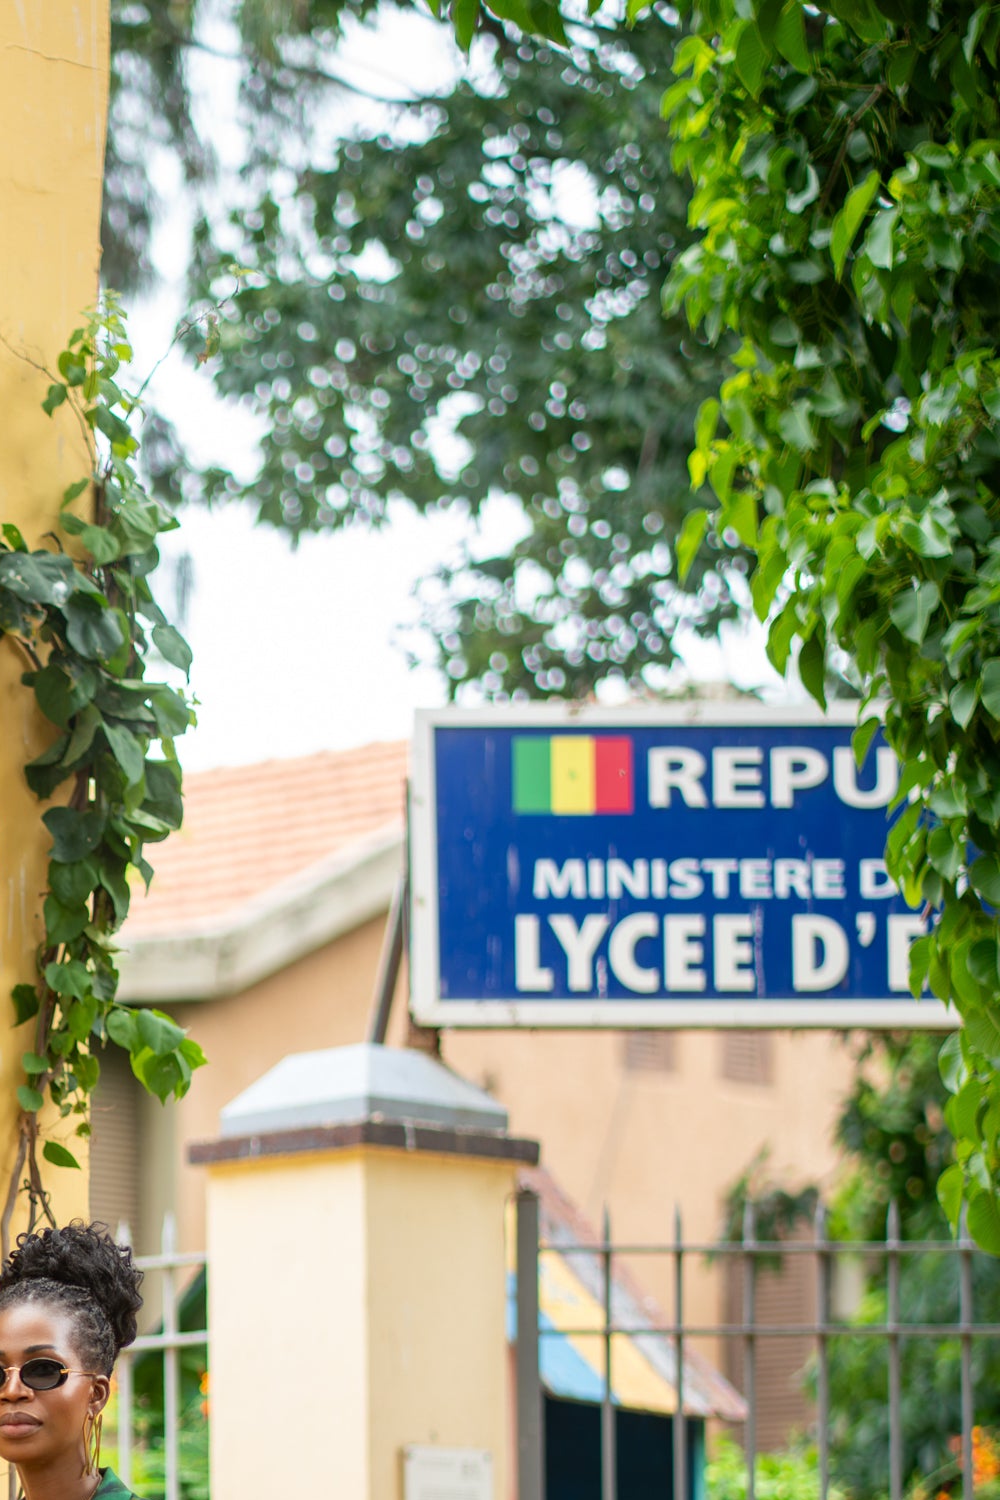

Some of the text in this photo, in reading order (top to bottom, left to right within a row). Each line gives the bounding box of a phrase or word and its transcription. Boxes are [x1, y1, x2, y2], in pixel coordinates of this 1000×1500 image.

[648, 746, 899, 808] REPU
[534, 858, 845, 899] MINISTERE
[515, 913, 756, 992] LYCEE
